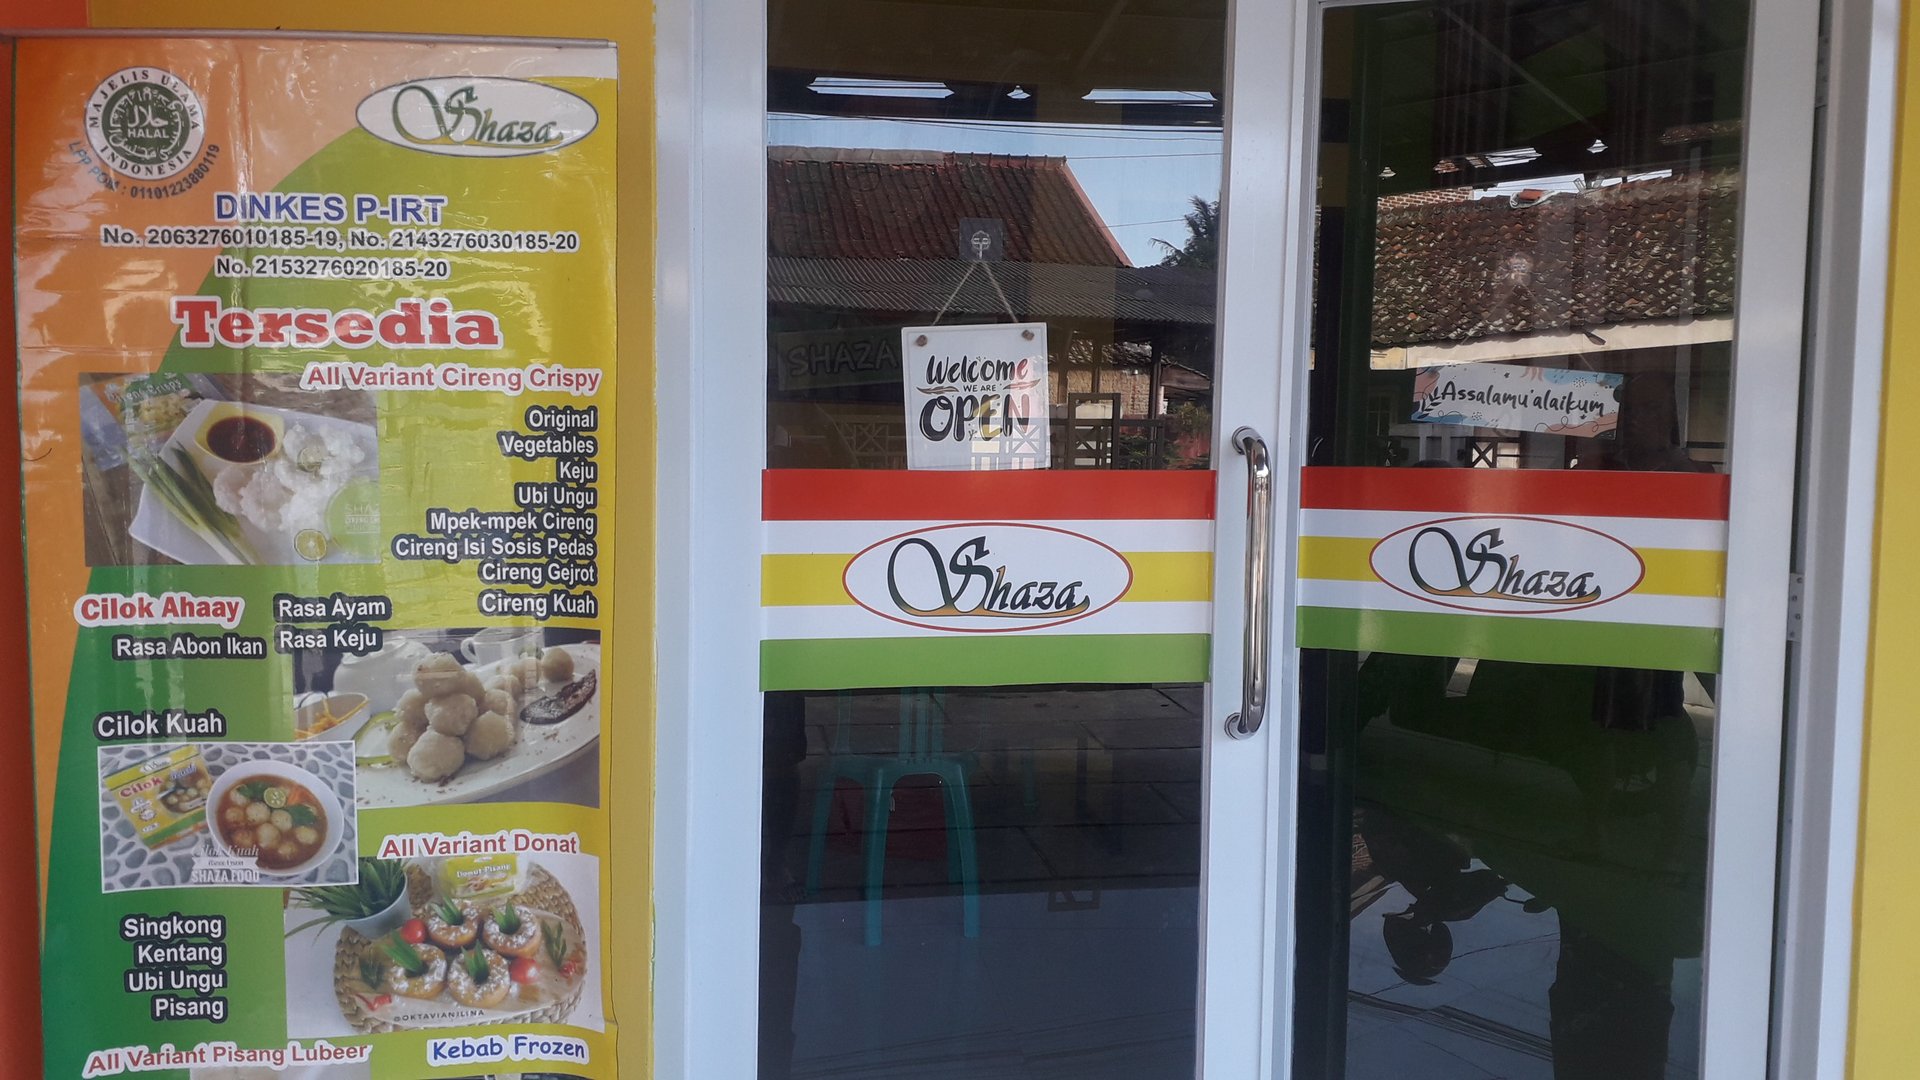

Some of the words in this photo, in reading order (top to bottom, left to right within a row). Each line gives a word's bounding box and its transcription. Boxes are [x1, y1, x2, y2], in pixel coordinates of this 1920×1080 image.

[88, 69, 149, 128] MAJELIS
[161, 74, 200, 130] ULAMA
[127, 104, 169, 127] حلال
[127, 128, 169, 139] HALAL
[100, 145, 192, 176] INDONESIA
[215, 194, 345, 221] DINKES
[357, 196, 445, 223] P-IRT
[103, 228, 140, 244] No.
[148, 228, 343, 249] 2063276010185-19,
[351, 231, 385, 247] No.
[392, 231, 577, 250] 2143276030185-20
[217, 258, 248, 274] No.
[255, 258, 448, 277] 2153276020185-20
[174, 300, 499, 347] Tersedia
[787, 340, 898, 378] SHAZA
[925, 354, 1029, 385] Welcome
[308, 366, 340, 387] All
[348, 366, 435, 388] Variant
[442, 368, 522, 391] Cireng
[530, 369, 600, 393] Crispy
[963, 384, 978, 392] WE
[980, 384, 996, 392] ARE
[529, 410, 594, 431] Original
[919, 394, 1030, 442] OPEN
[502, 435, 595, 457] Vegetables
[560, 462, 594, 483] Keju
[518, 487, 548, 505] Ubi
[553, 487, 594, 508] Ungu
[430, 512, 537, 533] Mpek-mpek
[543, 513, 594, 534] Cireng
[396, 539, 458, 559] Cireng
[464, 538, 485, 555] Isi
[491, 538, 542, 555] Sosis
[547, 538, 594, 556] Pedas
[482, 563, 543, 584] Cireng
[547, 564, 595, 585] Gejrot
[1408, 526, 1602, 605] Shaza
[887, 535, 1091, 619] Shaza
[81, 597, 154, 620] Cilok
[161, 596, 240, 623] Ahaay
[279, 599, 327, 617] Rasa
[331, 598, 386, 620] Ayam
[482, 593, 547, 616] Cireng
[553, 594, 595, 614] Kuah
[116, 637, 166, 657] Rasa
[172, 637, 221, 655] Abon
[227, 636, 263, 655] Ikan
[279, 630, 327, 649] Rasa
[333, 629, 377, 651] Keju
[98, 713, 159, 737] Cilok
[166, 712, 223, 734] Kuah
[119, 776, 162, 797] Cilok
[382, 838, 414, 857] All
[422, 835, 506, 855] Variant
[515, 833, 577, 854] Donat
[191, 869, 229, 882] SHAZA
[231, 869, 259, 882] FOOD
[124, 917, 222, 939] Singkong
[138, 944, 223, 966] Kentang
[128, 971, 163, 992] Ubi
[170, 970, 223, 993] Ungu
[155, 998, 224, 1019] Pisang
[88, 1053, 119, 1073] All
[127, 1048, 206, 1067] Variant
[213, 1045, 285, 1065] Pisang
[292, 1043, 368, 1061] Lubeer
[433, 1037, 502, 1060] Kebab
[515, 1035, 585, 1058] Frozen
